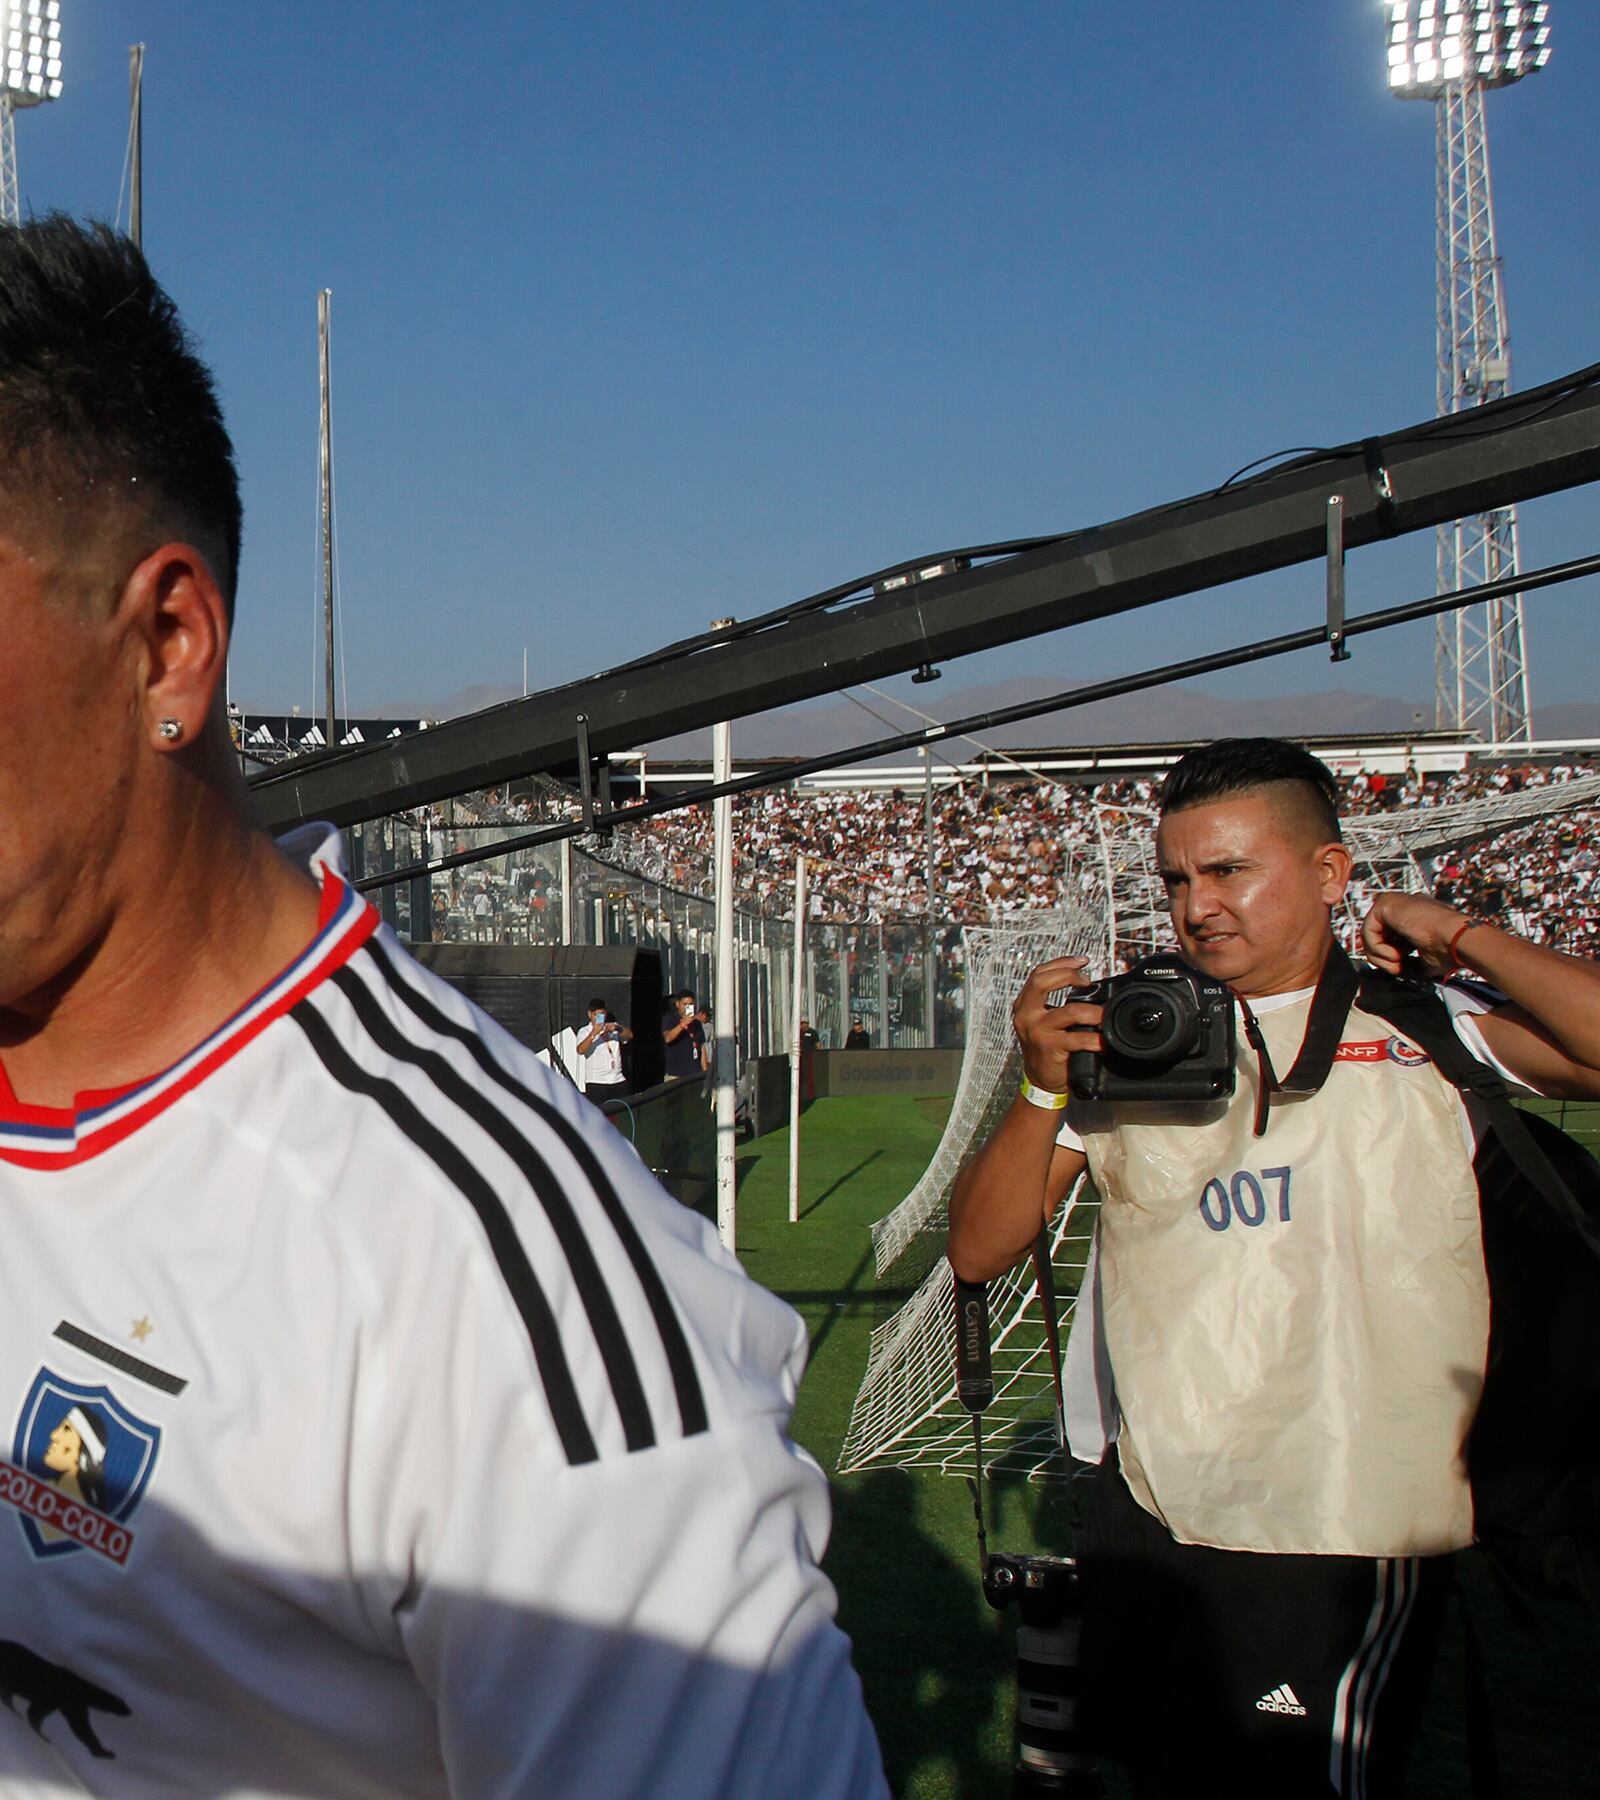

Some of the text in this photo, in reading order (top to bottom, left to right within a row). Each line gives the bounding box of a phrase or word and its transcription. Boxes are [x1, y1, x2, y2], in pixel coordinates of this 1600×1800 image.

[1143, 968, 1175, 976] Canon
[1199, 1165, 1291, 1232] 007
[965, 1300, 980, 1362] Canon
[1255, 1699, 1307, 1716] adidas
